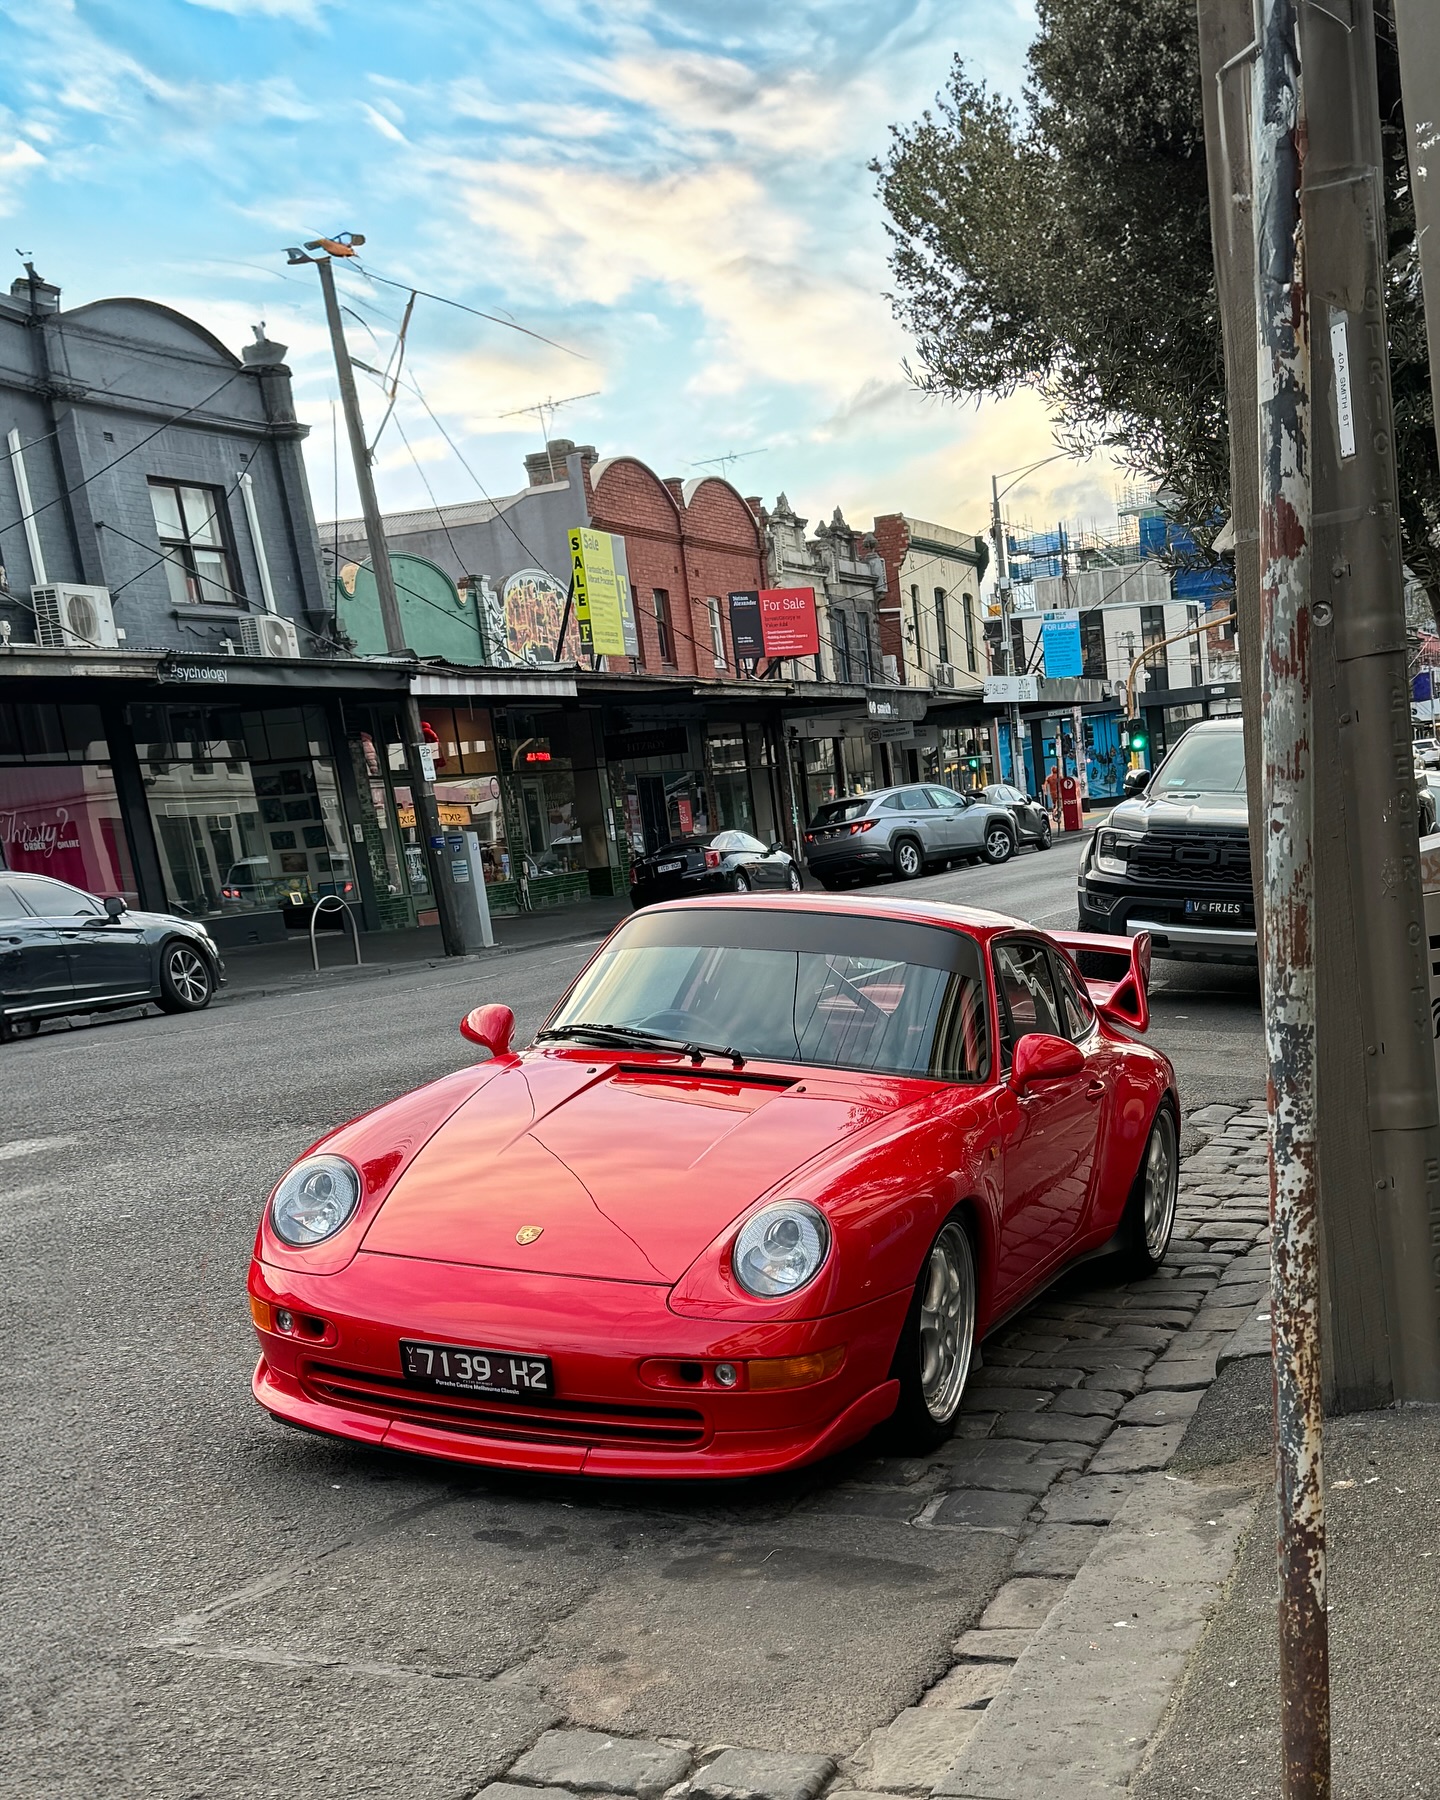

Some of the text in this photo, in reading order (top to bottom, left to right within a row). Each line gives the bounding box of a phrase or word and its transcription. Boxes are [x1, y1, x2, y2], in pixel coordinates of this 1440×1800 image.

[1340, 376, 1349, 410] SMITH
[1342, 415, 1350, 429] ST
[583, 533, 600, 552] Sale
[571, 537, 587, 607] SALE
[762, 597, 806, 611] For Sale
[1057, 622, 1077, 630] LEASE
[420, 748, 431, 758] 2P
[23, 840, 80, 851] ORDER ONLINE
[1193, 901, 1200, 911] V
[1209, 903, 1240, 914] FRIES
[416, 1348, 548, 1389] 7139 H2
